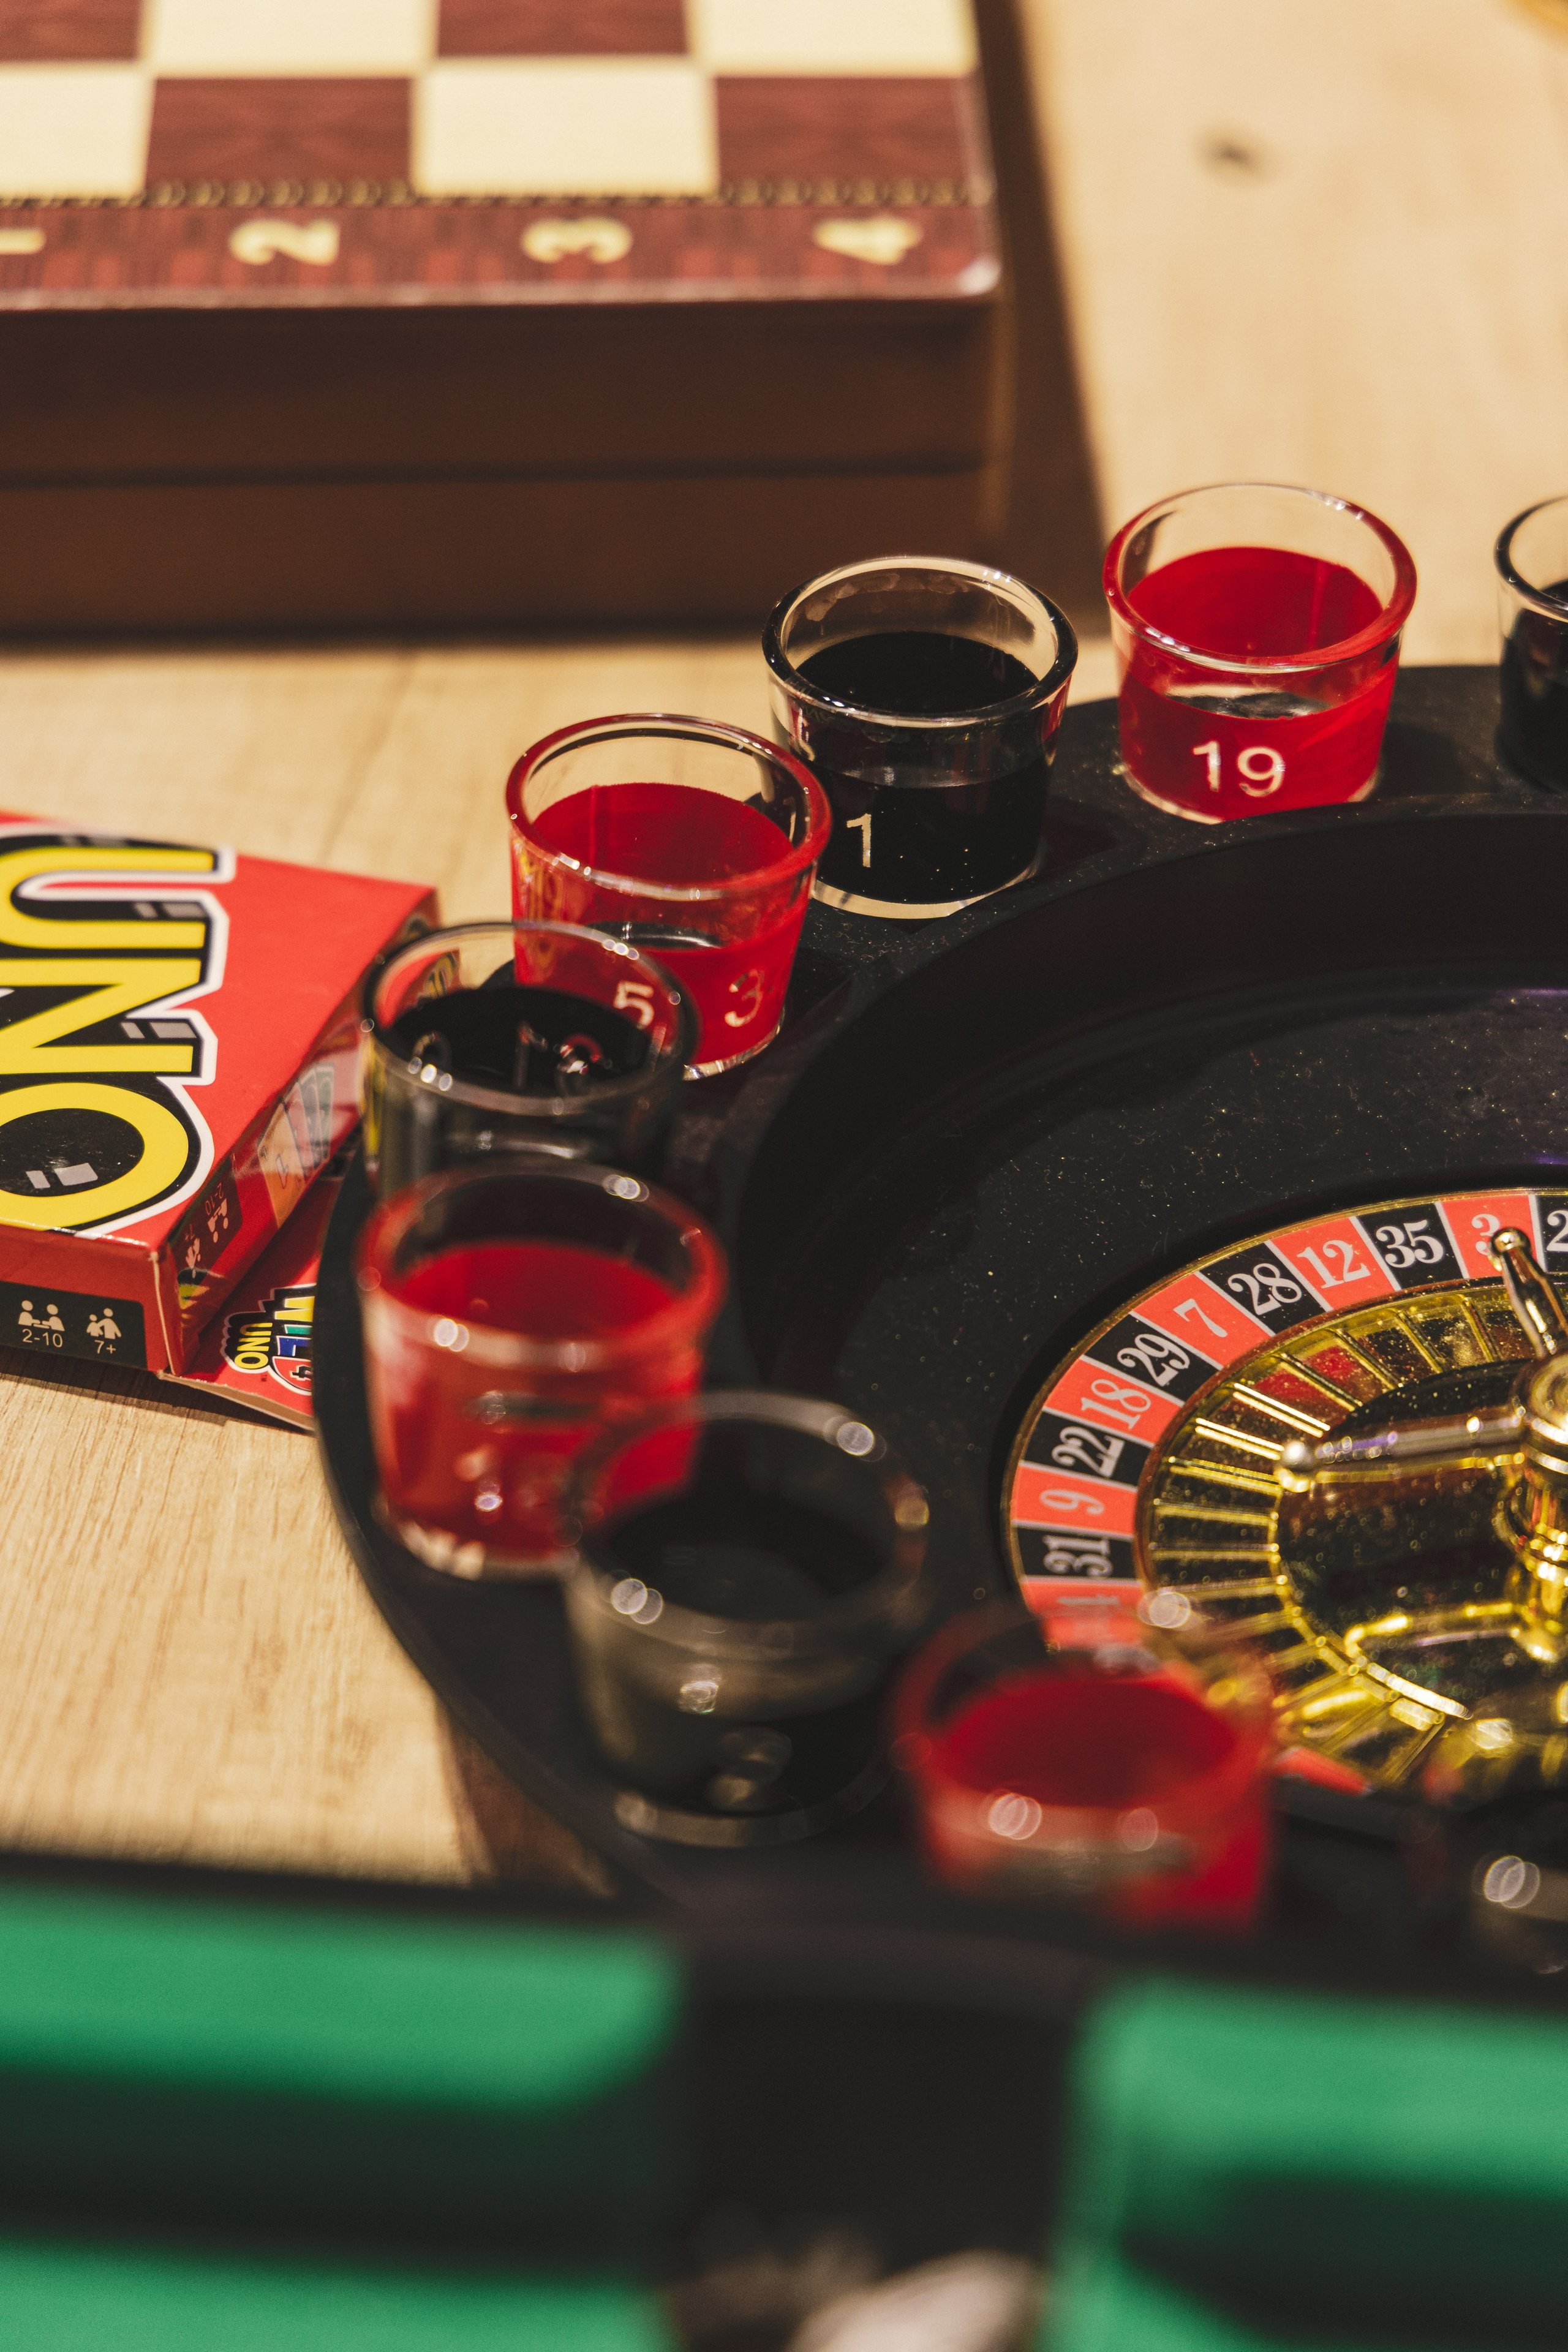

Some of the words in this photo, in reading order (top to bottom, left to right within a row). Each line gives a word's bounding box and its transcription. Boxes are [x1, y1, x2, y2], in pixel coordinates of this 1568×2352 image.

[231, 218, 340, 266] 2
[524, 216, 631, 264] 3
[1193, 741, 1285, 797] 19
[846, 813, 872, 868] 1
[0, 840, 222, 1232] UNO
[1375, 1219, 1444, 1268] 35
[1547, 1210, 1568, 1252] 2
[1297, 1238, 1371, 1289] 12
[1227, 1262, 1303, 1316] 28
[22, 1329, 63, 1348] 2-10
[1172, 1298, 1227, 1338] 7
[94, 1340, 116, 1354] 7+
[234, 1322, 273, 1370] UNO
[1117, 1333, 1191, 1388] 29
[1080, 1378, 1152, 1430] 18
[1052, 1426, 1125, 1479] 22
[1040, 1489, 1104, 1517] 9
[1043, 1534, 1114, 1578] 31
